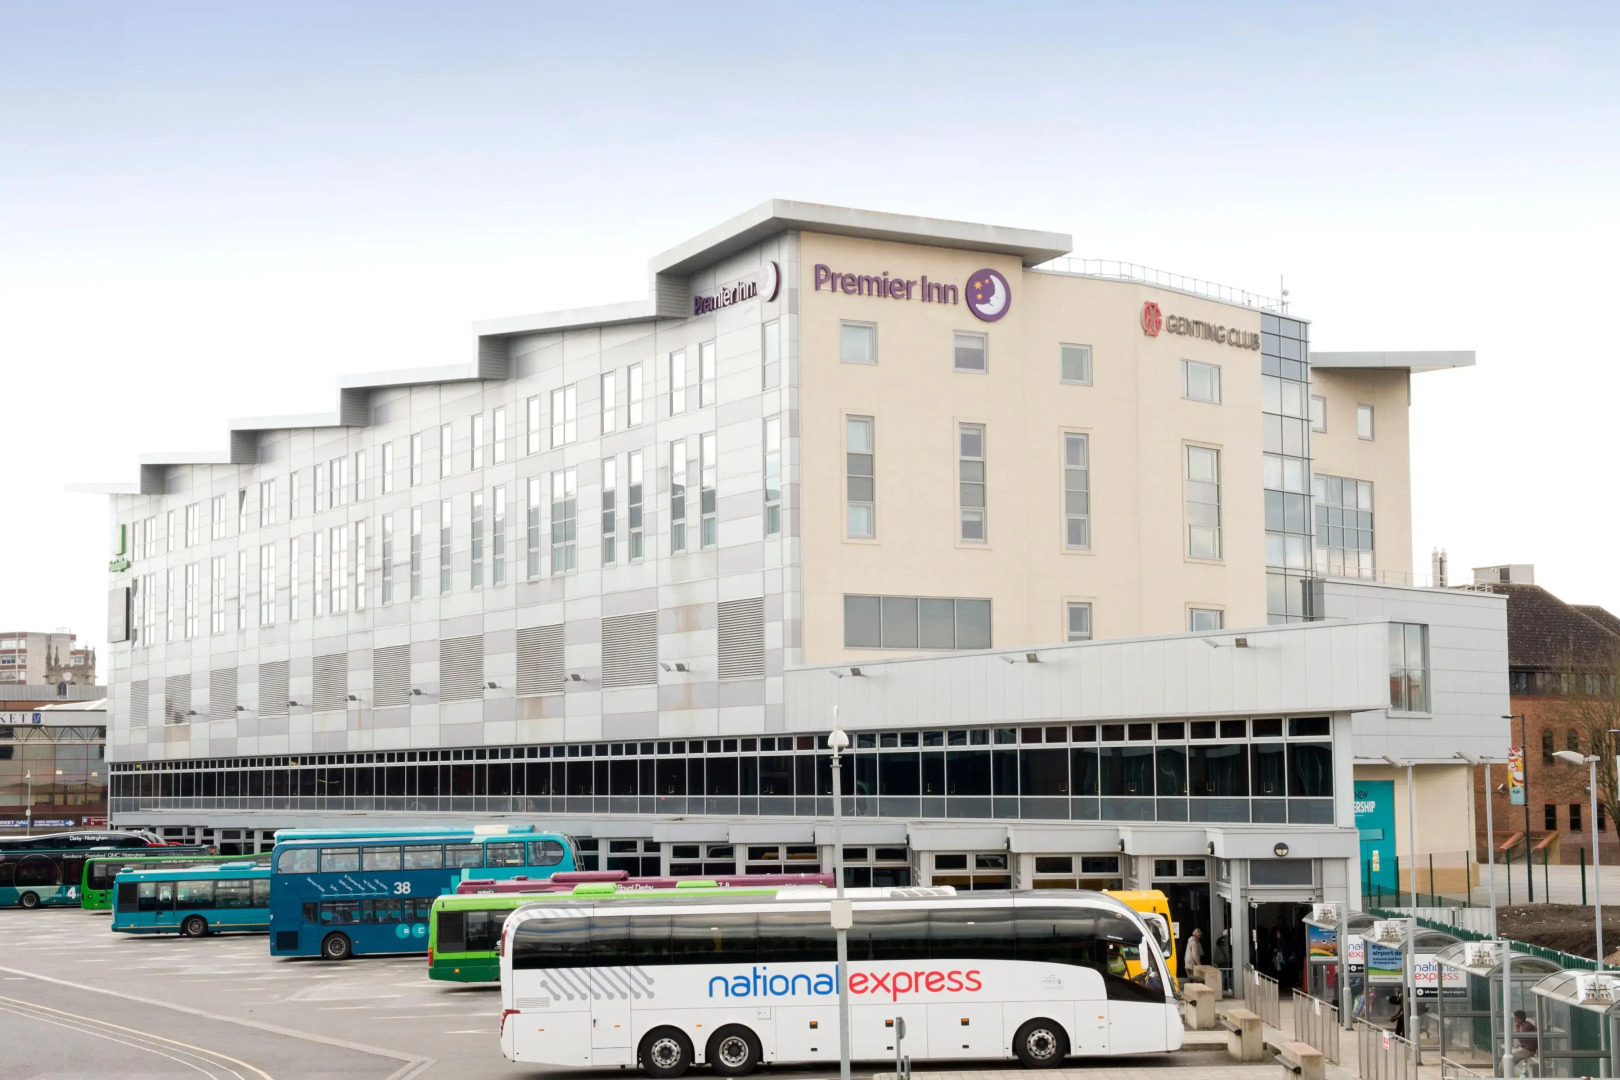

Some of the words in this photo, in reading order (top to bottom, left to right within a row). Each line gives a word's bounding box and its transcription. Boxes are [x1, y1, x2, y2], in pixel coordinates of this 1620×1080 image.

[814, 263, 917, 300] Premier
[921, 274, 959, 305] Inn
[693, 284, 735, 316] Premier
[736, 281, 757, 303] Inn
[1166, 314, 1226, 344] GENTING
[1227, 327, 1260, 351] CLUB
[1354, 790, 1369, 800] NEW
[69, 835, 82, 843] Derby
[84, 835, 109, 843] Nottingham
[66, 886, 76, 899] 4
[393, 881, 411, 895] 38
[708, 964, 840, 998] national
[848, 969, 982, 1002] express
[1415, 972, 1459, 983] expess
